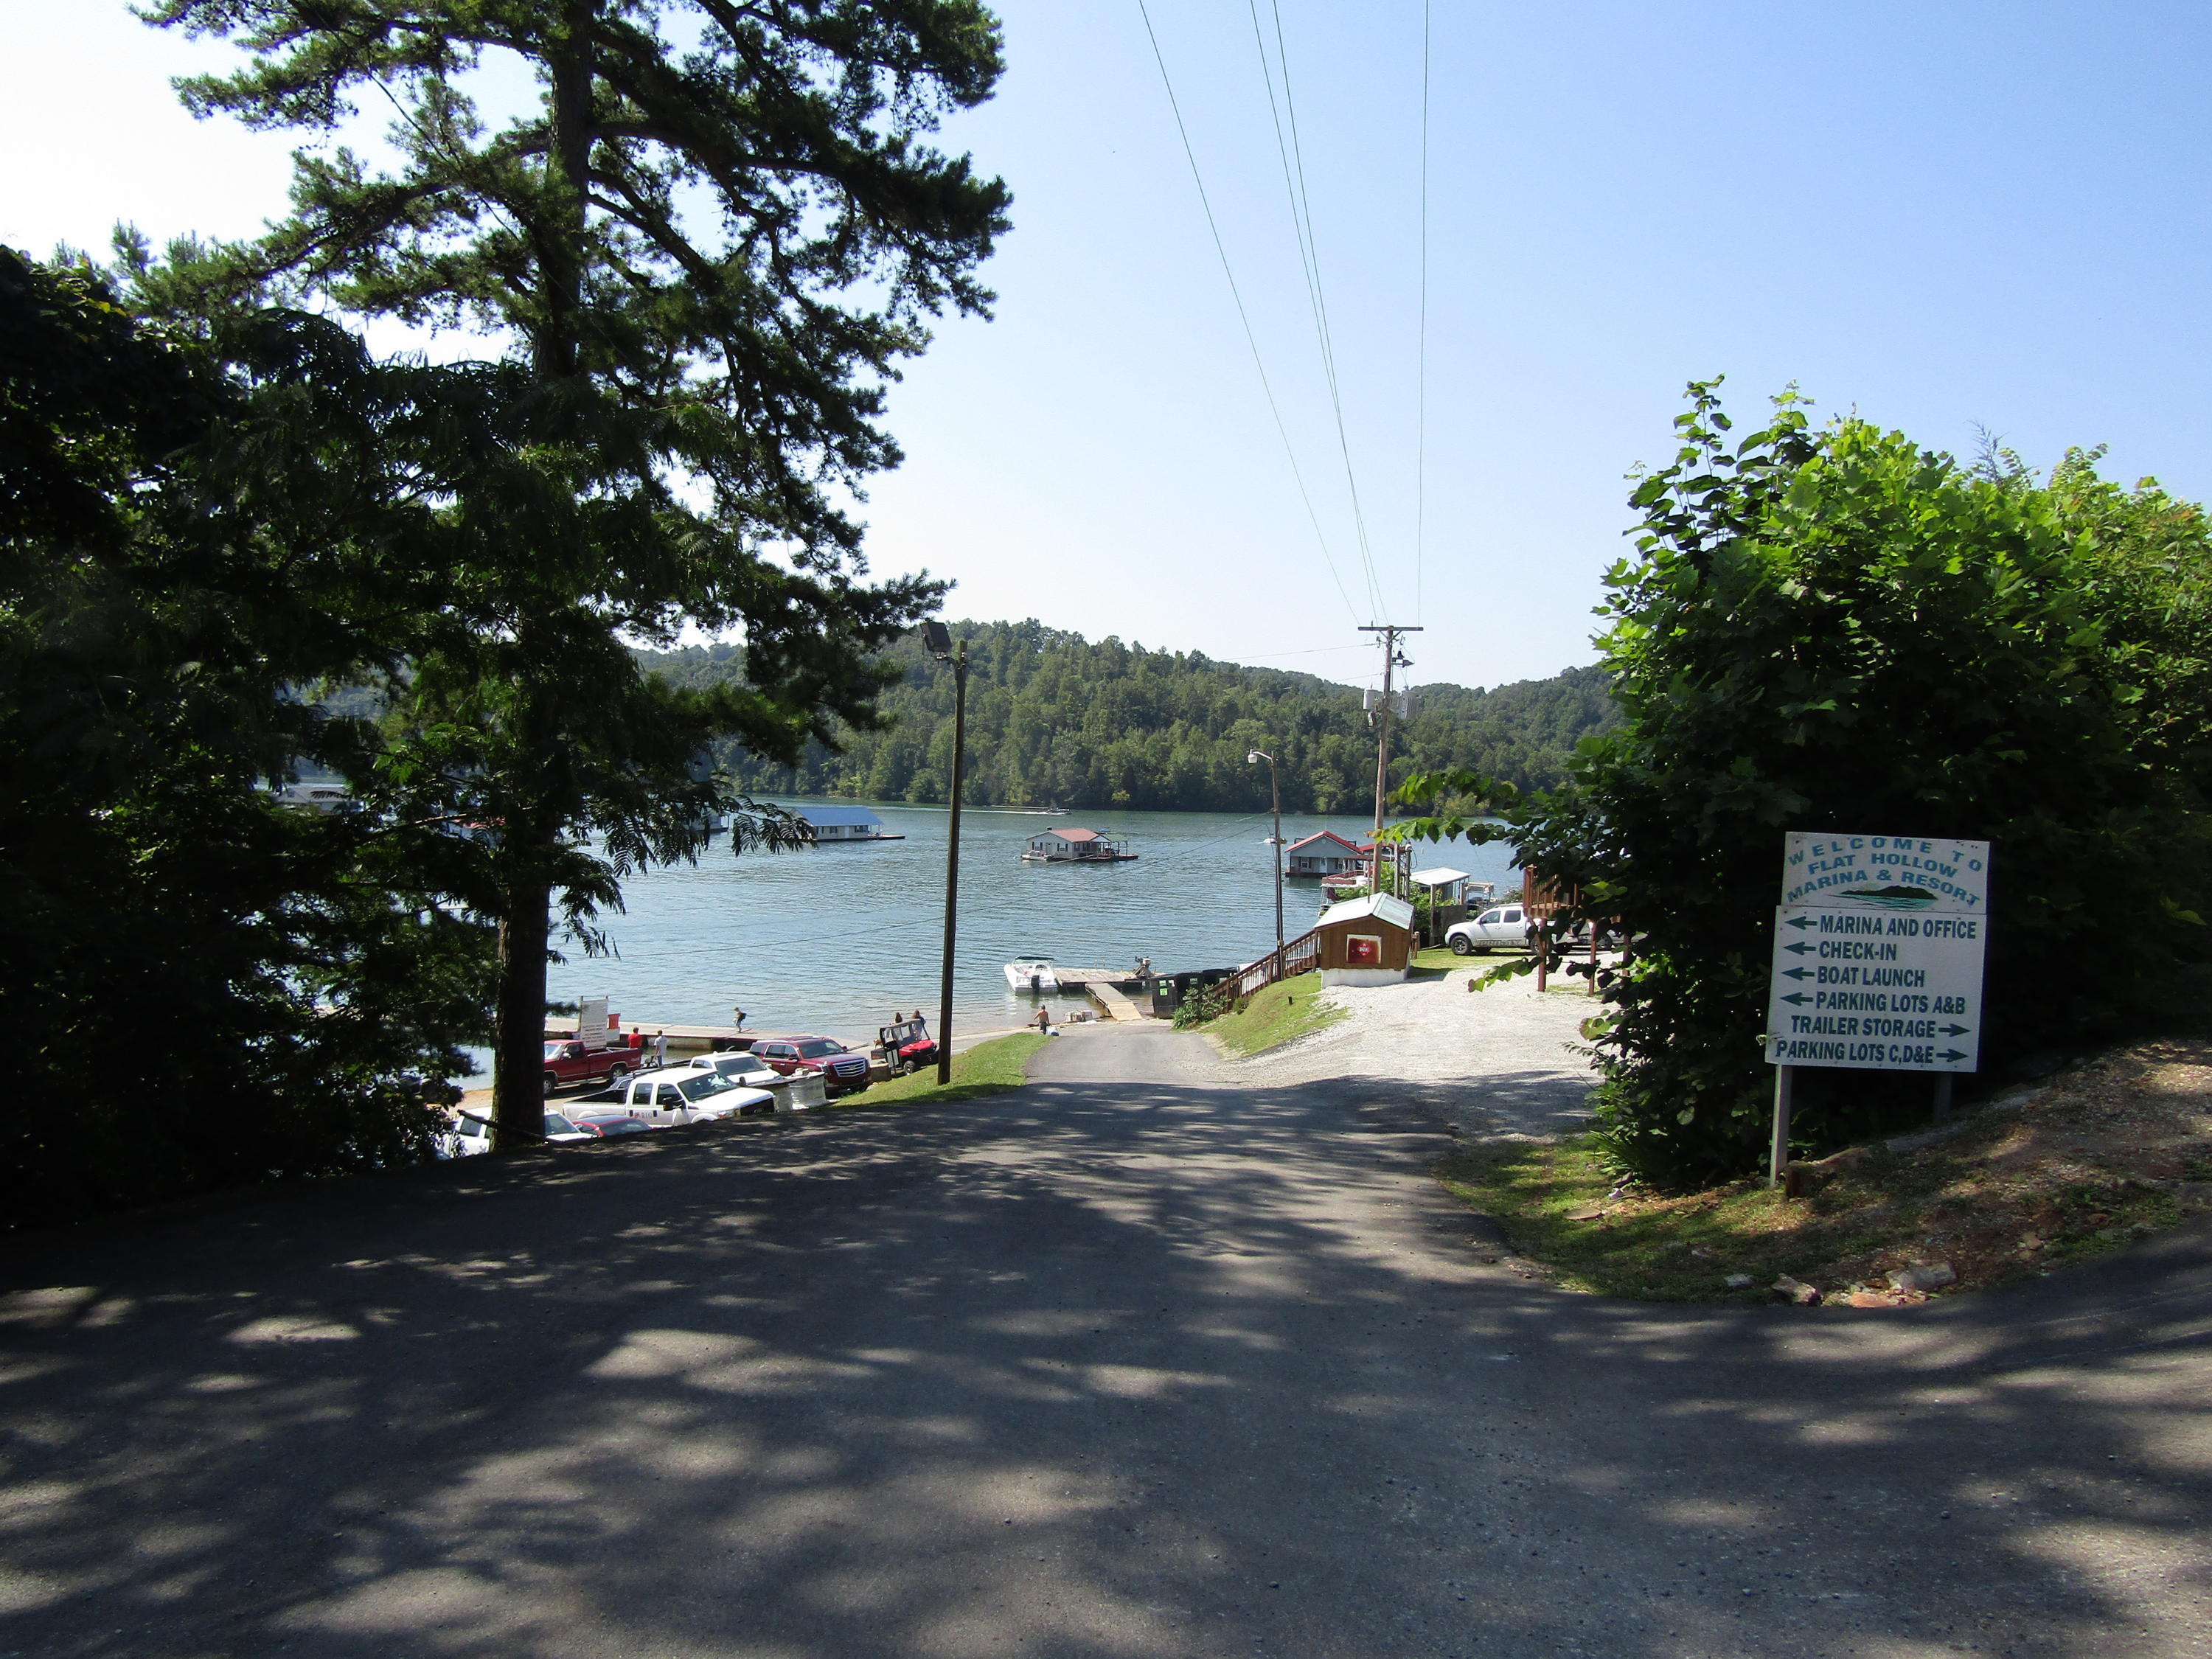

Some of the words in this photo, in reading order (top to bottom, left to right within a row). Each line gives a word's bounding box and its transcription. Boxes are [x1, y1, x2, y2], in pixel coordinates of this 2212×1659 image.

[1788, 836, 1933, 866] WELCOME
[1952, 850, 1982, 872] TO
[1808, 855, 1856, 875] FLAT
[1871, 853, 1959, 878] HOLLOW
[1787, 869, 1868, 902] MARINA
[1877, 869, 1893, 880] &
[1901, 871, 1980, 907] RESORT
[1820, 914, 1882, 935] MARINA
[1885, 918, 1918, 936] AND
[1922, 919, 1977, 939] OFFICE
[1819, 940, 1897, 961] CHECK-IN
[1817, 965, 1860, 985] BOAT
[1862, 967, 1925, 987] LAUNCH
[1815, 991, 1887, 1012] PARKING
[1891, 994, 1929, 1013] LOTS
[1932, 995, 1966, 1015] A&B
[1791, 1015, 1858, 1035] TRAILER
[1862, 1018, 1936, 1038] STORAGE
[1775, 1040, 1845, 1060] PARKING
[1848, 1043, 1885, 1062] LOTS
[1889, 1044, 1935, 1065] C,D&E
